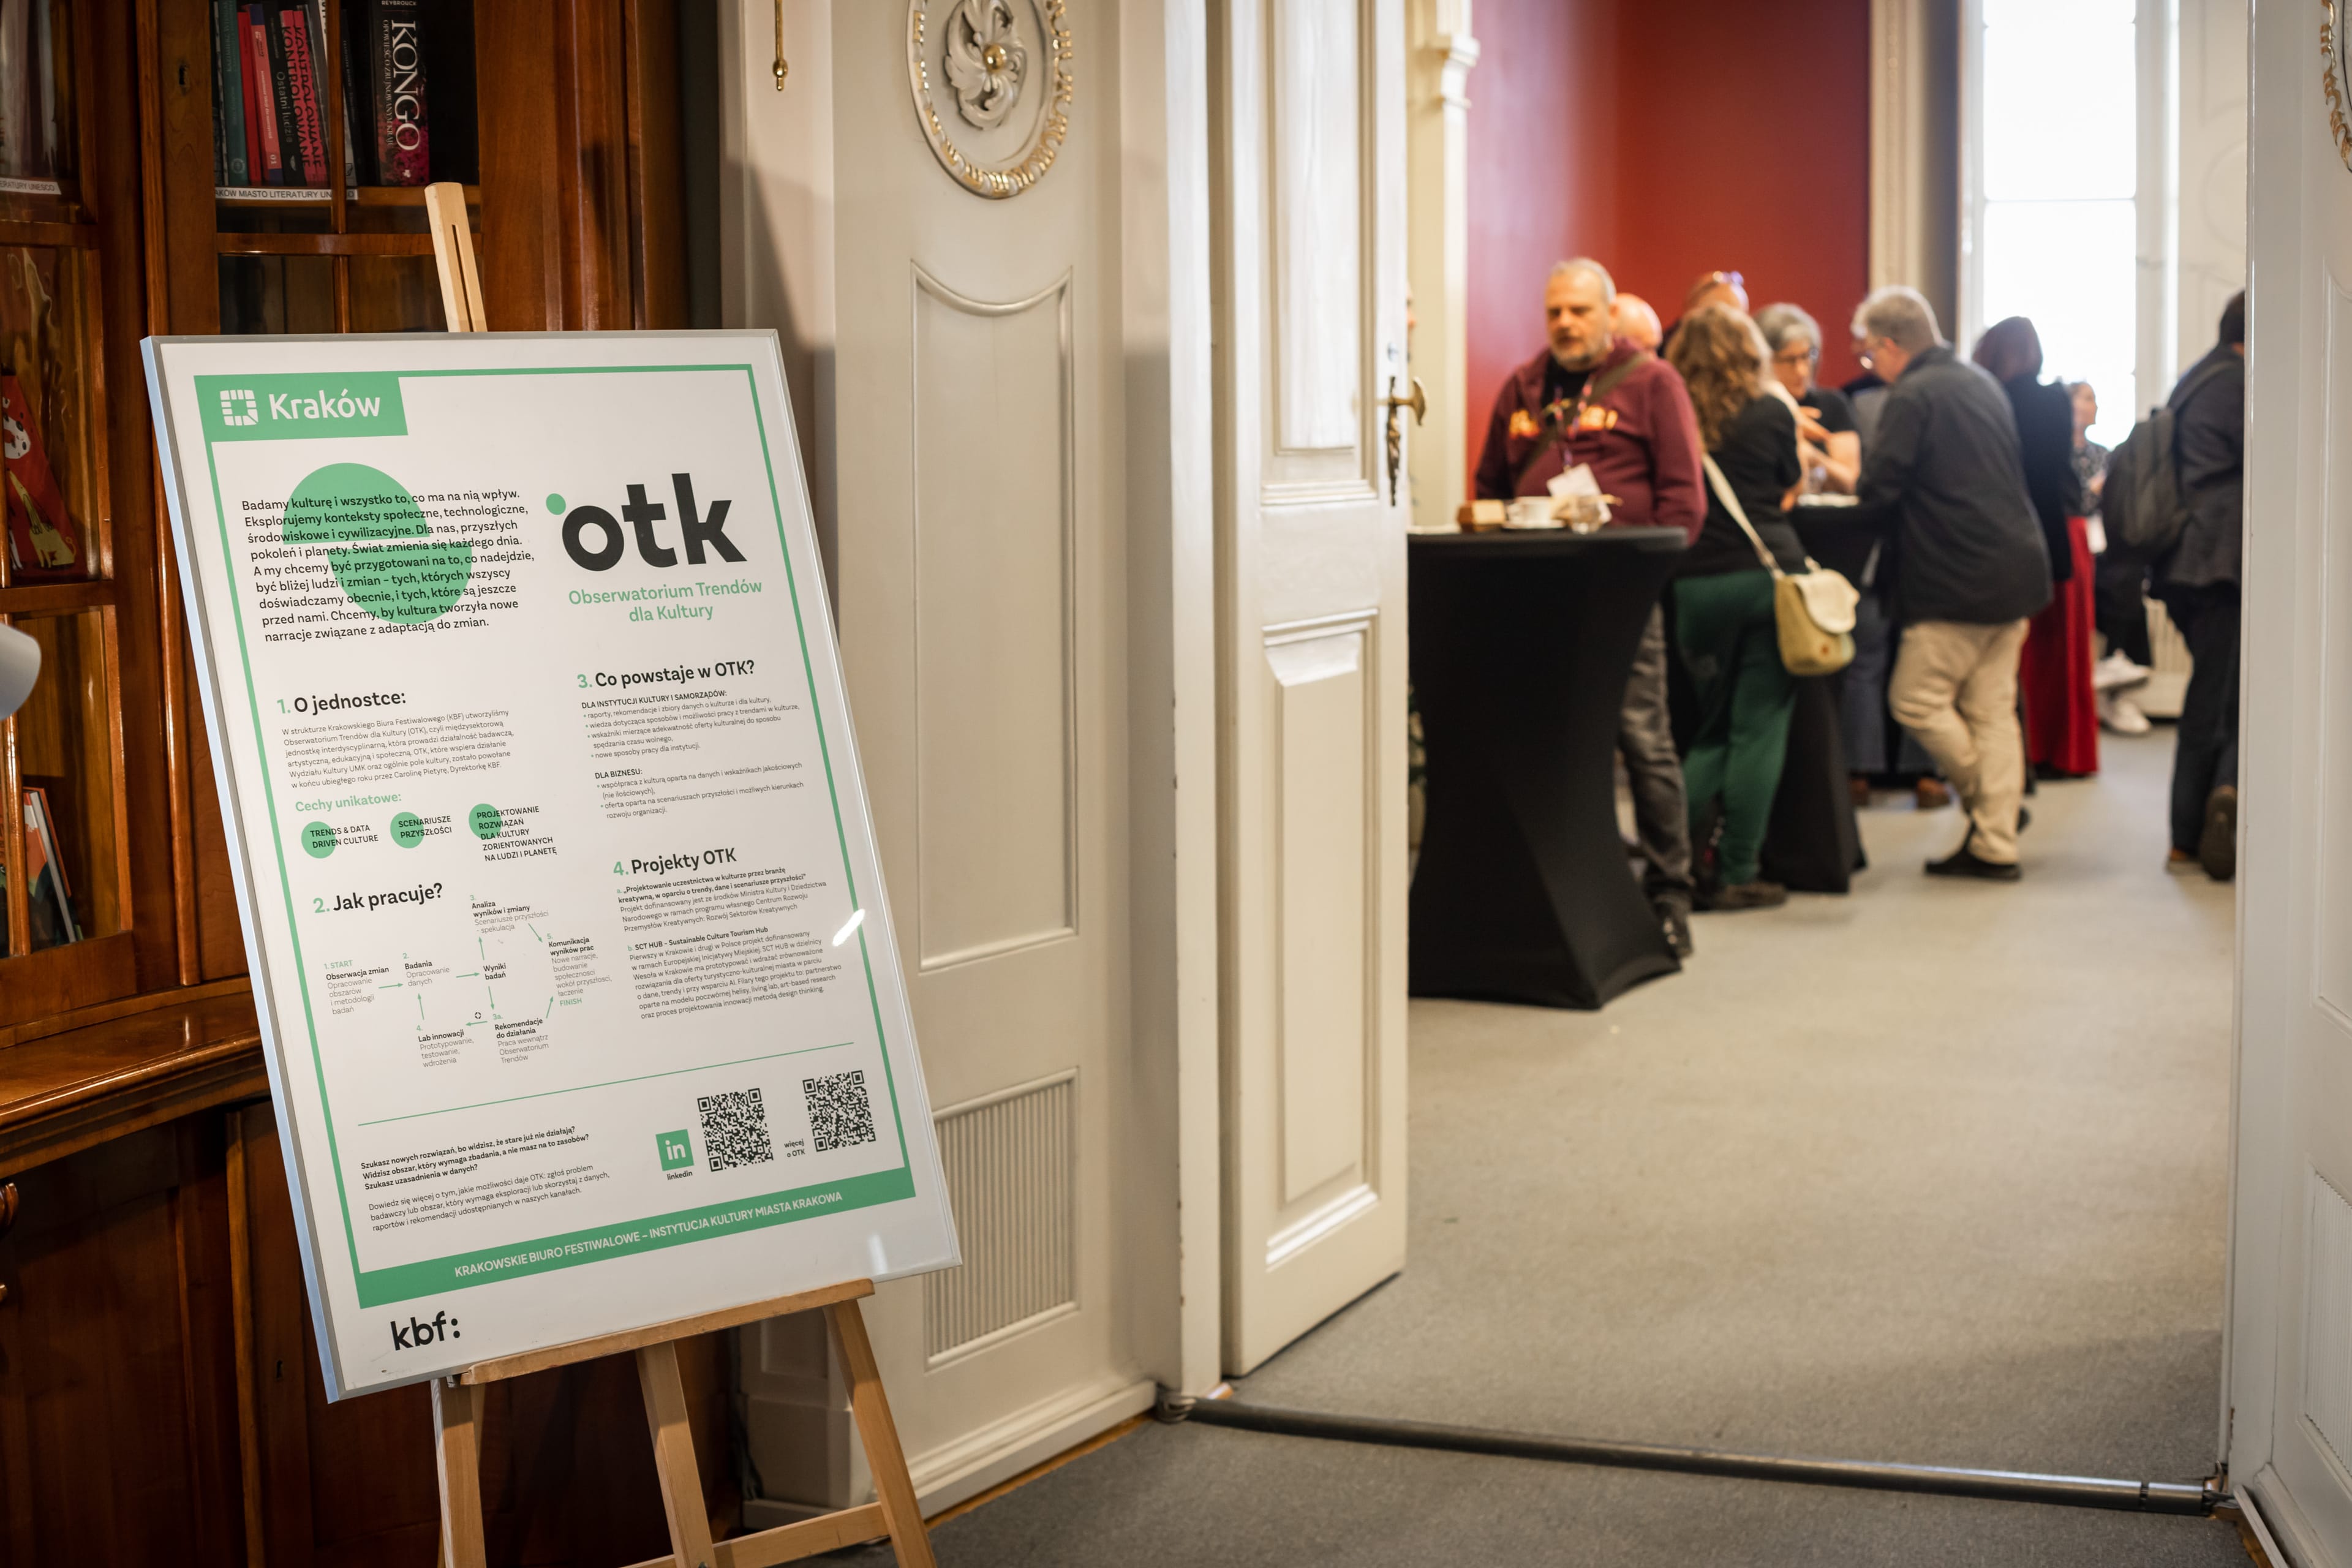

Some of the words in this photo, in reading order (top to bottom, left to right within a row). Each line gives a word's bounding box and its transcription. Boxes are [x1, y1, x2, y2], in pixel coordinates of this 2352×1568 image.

[382, 20, 391, 58] OPOWIEŚĆ
[276, 72, 290, 110] Ostatni
[391, 20, 421, 151] KONGO
[282, 112, 294, 143] ludzie
[268, 388, 380, 420] Kraków
[241, 499, 289, 511] Badamy
[291, 497, 333, 509] kulturę
[334, 496, 338, 506] i
[340, 494, 393, 508] wszystko
[394, 494, 410, 505] to,
[462, 489, 481, 502] nią
[481, 488, 520, 502] wpływ.
[244, 514, 322, 529] Eksplorujemy
[324, 511, 380, 523] konteksty
[383, 508, 442, 522] społeczne,
[443, 504, 528, 518] technologiczne,
[562, 473, 747, 571] otk
[247, 530, 330, 543] środowiskowe
[331, 529, 335, 539] i
[337, 525, 414, 541] cywilizacyjne.
[415, 524, 434, 534] Dla
[436, 525, 459, 534] nas,
[460, 519, 518, 535] przyszłych
[250, 546, 296, 562] pokoleń
[298, 546, 303, 557] i
[304, 546, 350, 559] planety.
[352, 541, 385, 554] Świat
[386, 540, 429, 552] zmienia
[431, 539, 447, 551] się
[448, 537, 494, 549] każdego
[496, 535, 522, 546] dnia.
[254, 566, 262, 576] A
[264, 567, 281, 578] my
[284, 563, 328, 575] chcemy
[331, 560, 352, 574] być
[353, 556, 429, 573] przygotowani
[447, 556, 463, 565] to,
[480, 550, 535, 564] nadejdzie,
[568, 583, 694, 605] Obserwatorium
[695, 578, 762, 596] Trendów
[628, 606, 654, 622] dla
[656, 603, 713, 620] Kultury
[577, 674, 592, 688] 3.
[595, 672, 617, 687] Co
[620, 665, 695, 689] powstaje
[696, 667, 710, 679] w
[714, 659, 755, 677] OTK?
[277, 699, 291, 714] 1.
[294, 696, 308, 713] O
[312, 692, 406, 716] jednostce:
[596, 698, 638, 707] INSTYTUCJI
[638, 695, 669, 704] KULTURY
[674, 689, 727, 701] SAMORZĄDÓW:
[290, 726, 326, 735] strukturze
[327, 722, 375, 731] Krakowskiego
[394, 715, 446, 725] Festiwalowego
[446, 712, 464, 722] (KBF)
[465, 709, 509, 719] utworzyliśmy
[609, 768, 643, 777] BIZNESU:
[295, 798, 333, 812] Cechy
[334, 793, 402, 808] unikatowe:
[476, 805, 540, 819] PROJEKTOWANIE
[398, 815, 451, 827] SCENARIUSZE
[478, 816, 524, 829] ROZWIĄZAŃ
[309, 827, 342, 837] TRENDS
[350, 824, 371, 833] DATA
[400, 825, 452, 838] PRZYSZŁOŚCI
[480, 832, 496, 840] DLA
[496, 828, 529, 839] KULTURY
[312, 838, 342, 848] DRIVEN
[343, 834, 379, 845] CULTURE
[482, 837, 553, 851] ZORIENTOWANYCH
[496, 851, 519, 860] LUDZI
[523, 846, 557, 857] PLANETĘ
[613, 861, 629, 876] 4.
[631, 853, 699, 875] Projekty
[703, 847, 737, 865] OTK
[313, 897, 330, 913] 2.
[333, 892, 365, 911] Jak
[368, 882, 442, 911] pracuje?
[472, 900, 496, 909] Analiza
[473, 908, 502, 919] wyników
[507, 905, 530, 913] zmiany
[548, 936, 590, 948] Komunikacja
[634, 942, 647, 951] SCT
[648, 940, 663, 949] HUB
[668, 935, 706, 946] Sustainable
[729, 929, 755, 937] Tourism
[549, 946, 578, 957] wyników
[330, 959, 353, 969] START
[404, 960, 432, 970] Badania
[483, 962, 507, 973] Wyniki
[325, 969, 368, 981] Obserwacja
[368, 967, 390, 975] zmian
[484, 971, 506, 980] badań
[559, 997, 582, 1006] FINISH
[494, 1017, 543, 1030] Rekomendacje
[431, 1028, 464, 1040] innowacji
[505, 1027, 537, 1038] działania
[665, 1139, 686, 1161] in
[783, 1138, 804, 1148] więcej
[791, 1148, 805, 1156] OTK
[364, 1180, 394, 1190] Szukasz
[394, 1170, 441, 1185] uzasadnienia
[449, 1163, 478, 1175] danych?
[666, 1170, 693, 1180] linkedin
[454, 1253, 529, 1277] KRAKOWSKIE
[529, 1246, 564, 1262] BIURO
[564, 1231, 641, 1255] FESTIWALOWE
[649, 1218, 710, 1238] INSTYTUCJA
[710, 1208, 753, 1226] KULTURY
[755, 1201, 792, 1217] MIASTA
[792, 1191, 843, 1210] KRAKOWA
[390, 1310, 461, 1351] kbf:
